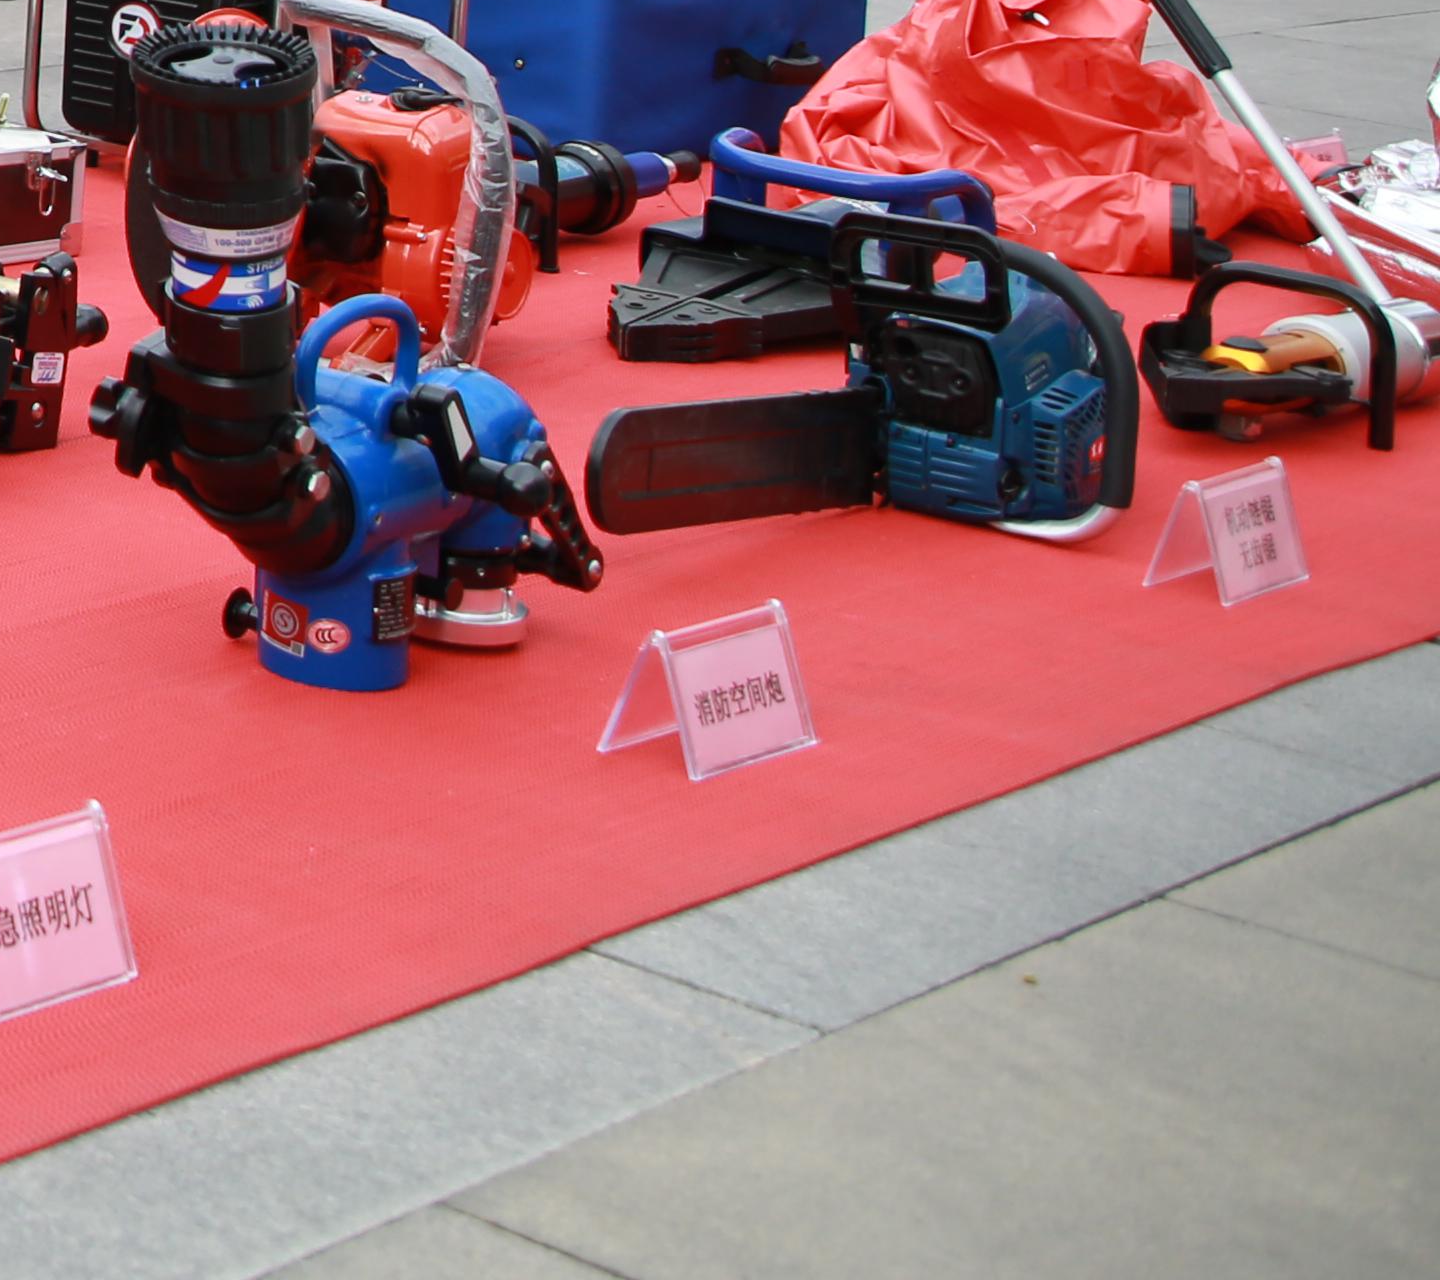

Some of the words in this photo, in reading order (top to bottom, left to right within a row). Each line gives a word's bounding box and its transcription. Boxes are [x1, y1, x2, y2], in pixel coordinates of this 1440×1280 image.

[693, 670, 787, 728] 消防空间炮
